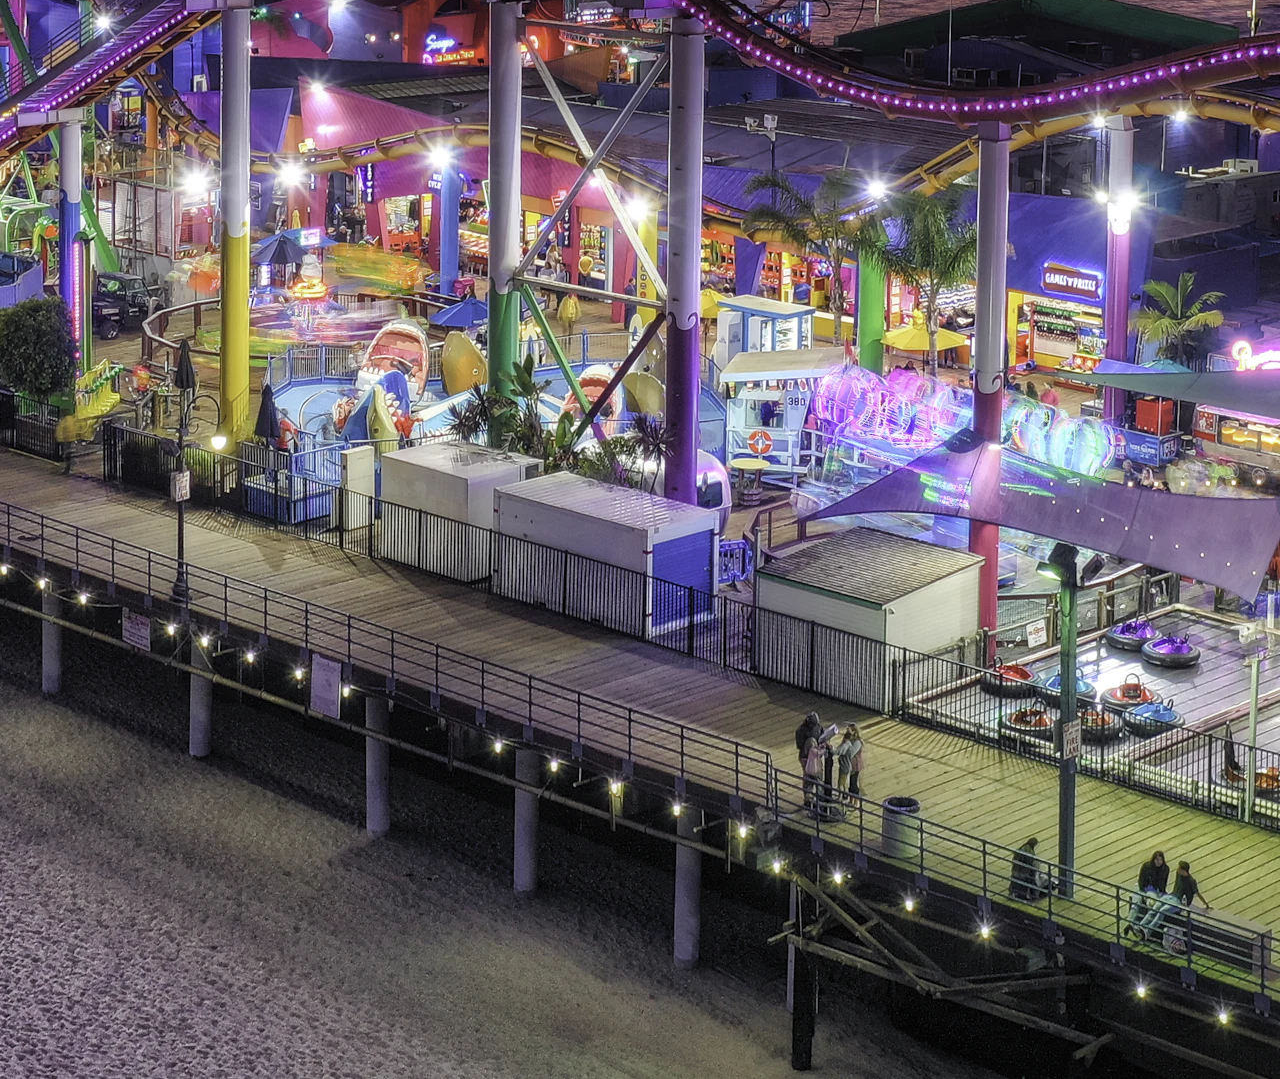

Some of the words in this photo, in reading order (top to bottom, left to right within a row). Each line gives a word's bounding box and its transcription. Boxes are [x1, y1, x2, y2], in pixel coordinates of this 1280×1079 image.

[1045, 273, 1067, 286] GAMES
[1073, 278, 1096, 291] PRIZES
[787, 397, 806, 406] 380
[1066, 735, 1079, 747] FIRE
[1065, 743, 1080, 757] LANE
